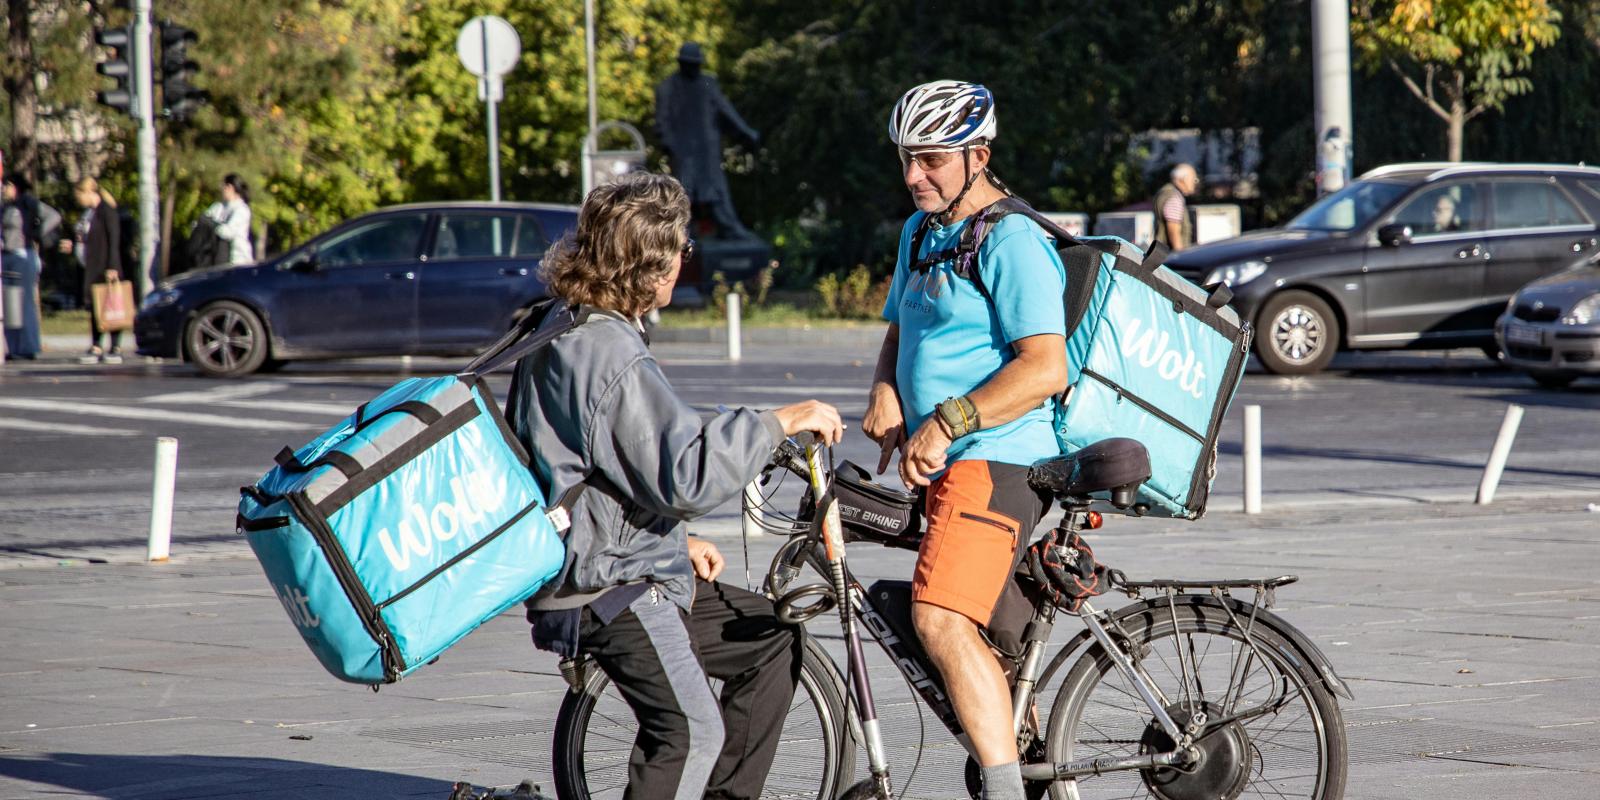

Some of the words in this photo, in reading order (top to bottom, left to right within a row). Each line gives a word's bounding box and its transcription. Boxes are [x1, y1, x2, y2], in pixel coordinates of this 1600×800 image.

[1121, 318, 1206, 398] Wolt
[839, 503, 861, 518] EST
[862, 510, 901, 530] BIKING
